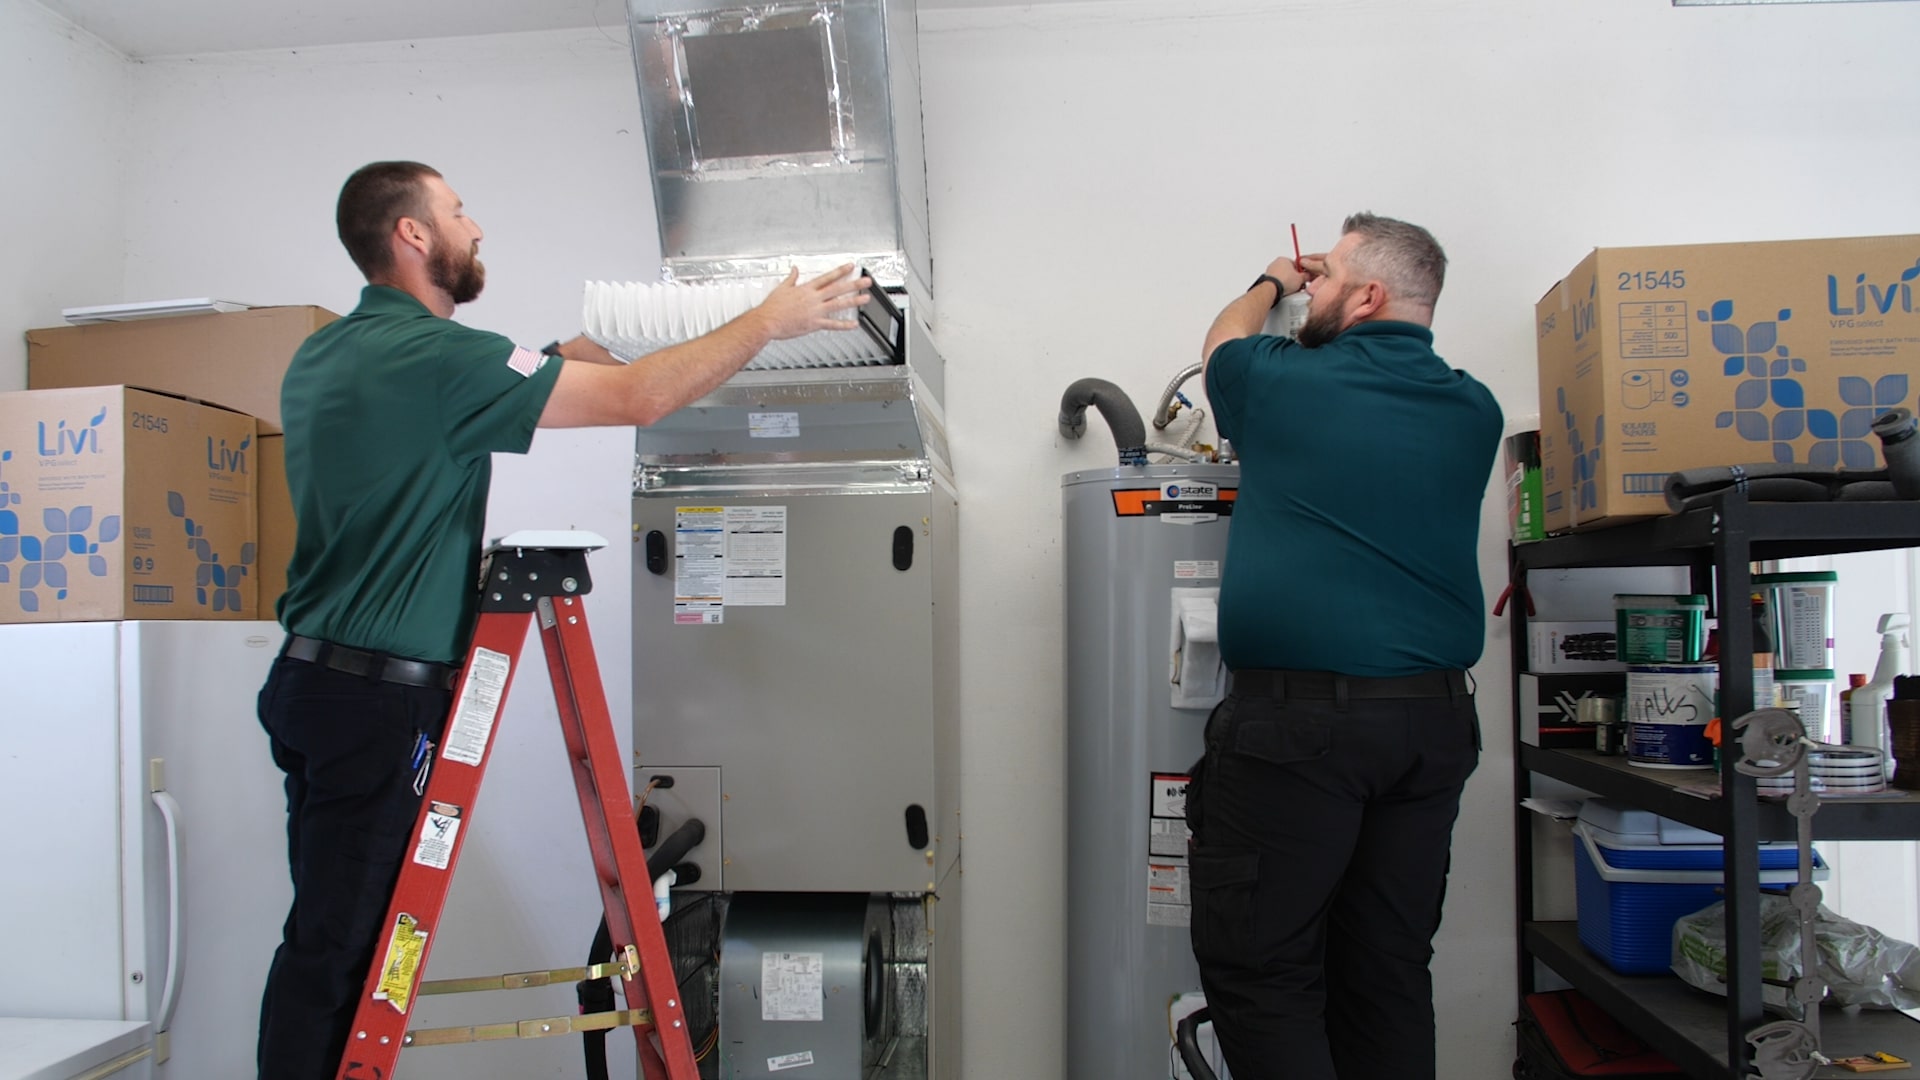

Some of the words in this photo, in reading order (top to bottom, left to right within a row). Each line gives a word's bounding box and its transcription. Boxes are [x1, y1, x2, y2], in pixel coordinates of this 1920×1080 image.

[1617, 269, 1686, 291] 21545
[1828, 257, 1920, 316] Livi
[38, 406, 107, 456] Livi
[132, 411, 168, 434] 21545
[207, 433, 251, 475] Livi
[1180, 486, 1213, 495] state
